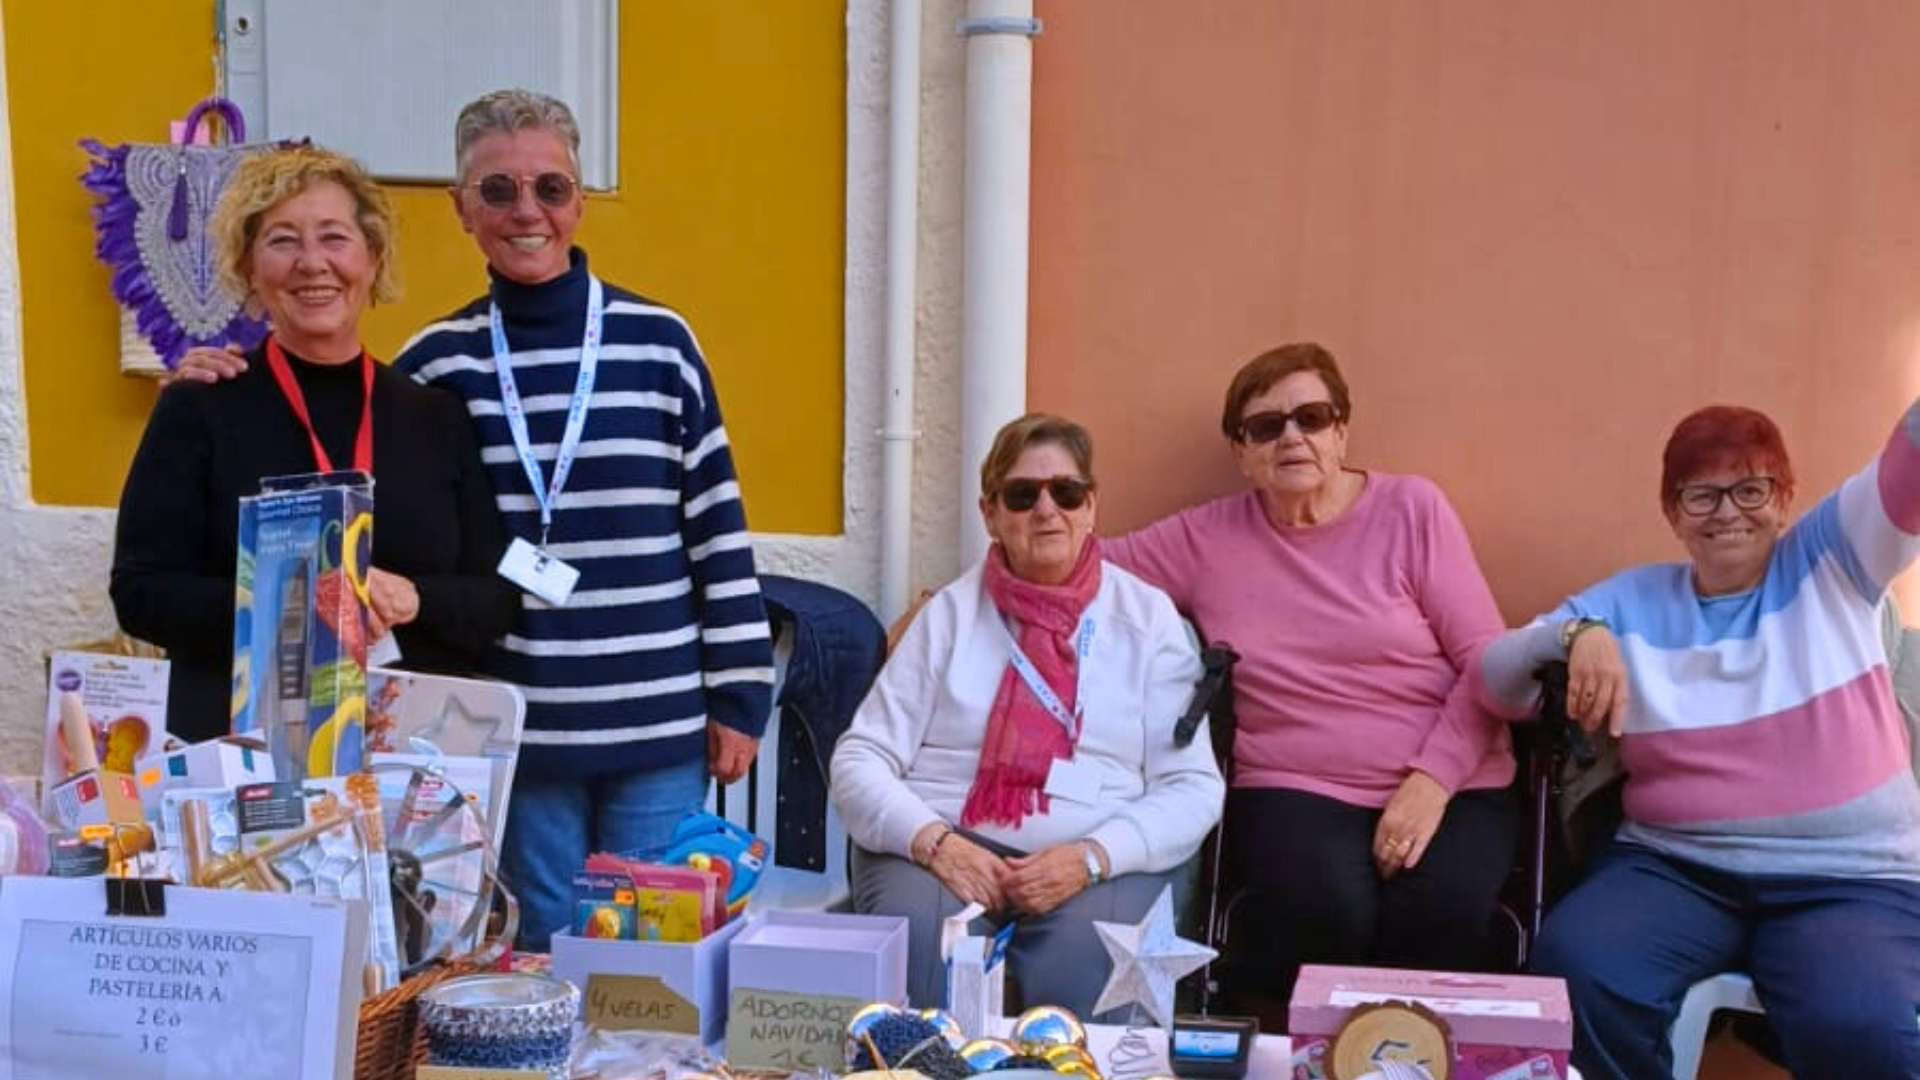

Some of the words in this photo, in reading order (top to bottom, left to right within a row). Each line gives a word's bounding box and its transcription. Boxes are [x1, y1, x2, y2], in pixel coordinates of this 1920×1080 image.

[69, 924, 183, 950] ARTÍCULOS
[187, 932, 258, 955] VARIOS
[94, 952, 122, 972] DE
[126, 954, 206, 977] COCINA
[215, 958, 230, 978] Y
[88, 977, 204, 1001] PASTELERÍA
[136, 1006, 147, 1025] 2
[590, 986, 609, 1019] 4
[610, 999, 676, 1021] VELAS
[139, 1034, 149, 1052] 3
